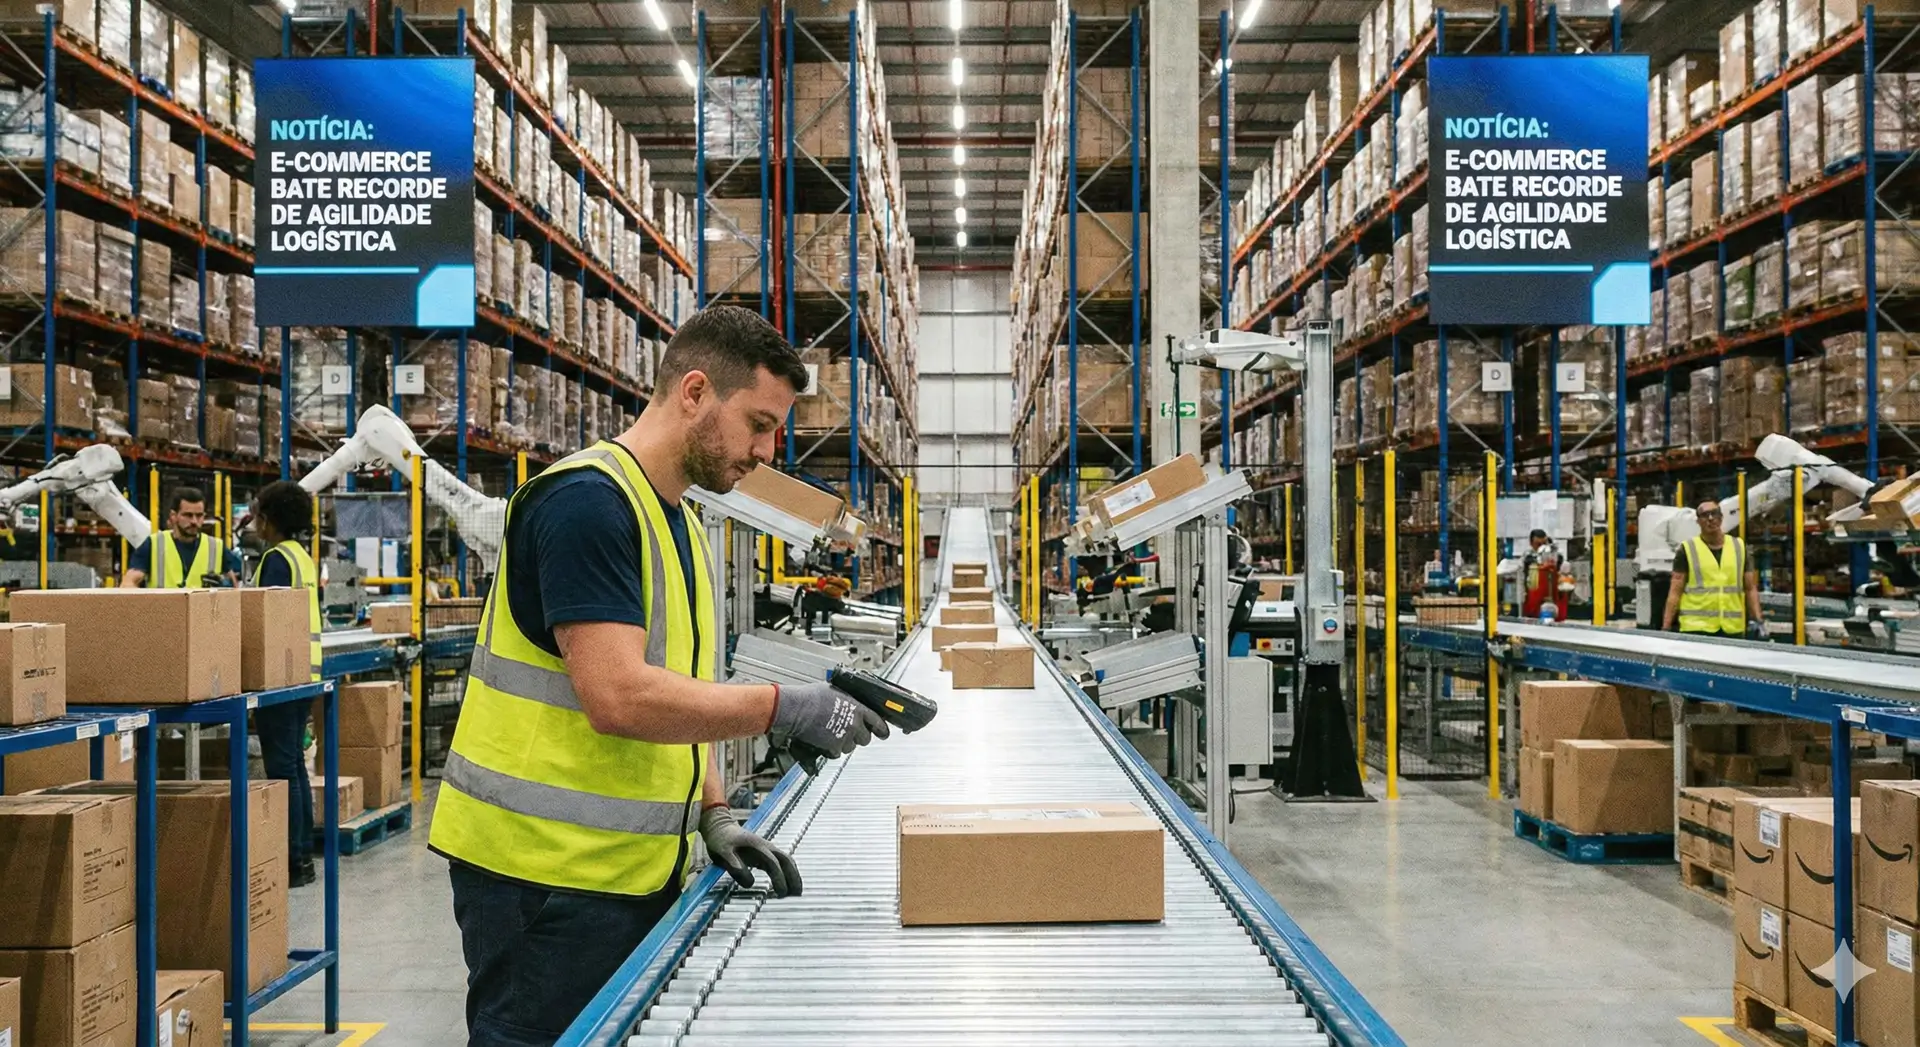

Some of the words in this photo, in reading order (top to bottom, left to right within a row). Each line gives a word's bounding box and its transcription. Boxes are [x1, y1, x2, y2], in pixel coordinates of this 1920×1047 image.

[271, 115, 374, 140] NOTÍCIA:
[1445, 112, 1549, 138] NOTÍCIA:
[271, 151, 432, 172] E-COMMERCE
[1445, 149, 1607, 170] E-COMMERCE
[271, 178, 332, 198] BATE
[338, 178, 447, 199] RECORDE
[1445, 176, 1508, 197] BATE
[1513, 176, 1623, 197] RECORDE
[271, 204, 302, 225] DE
[306, 204, 432, 225] AGILIDADE
[1445, 202, 1477, 223] DE
[1481, 202, 1607, 223] AGILIDADE
[271, 226, 397, 251] LOGÍSTICA
[1445, 224, 1572, 249] LOGÍSTICA
[331, 373, 341, 384] D
[406, 372, 414, 383] E
[1491, 369, 1501, 380] D
